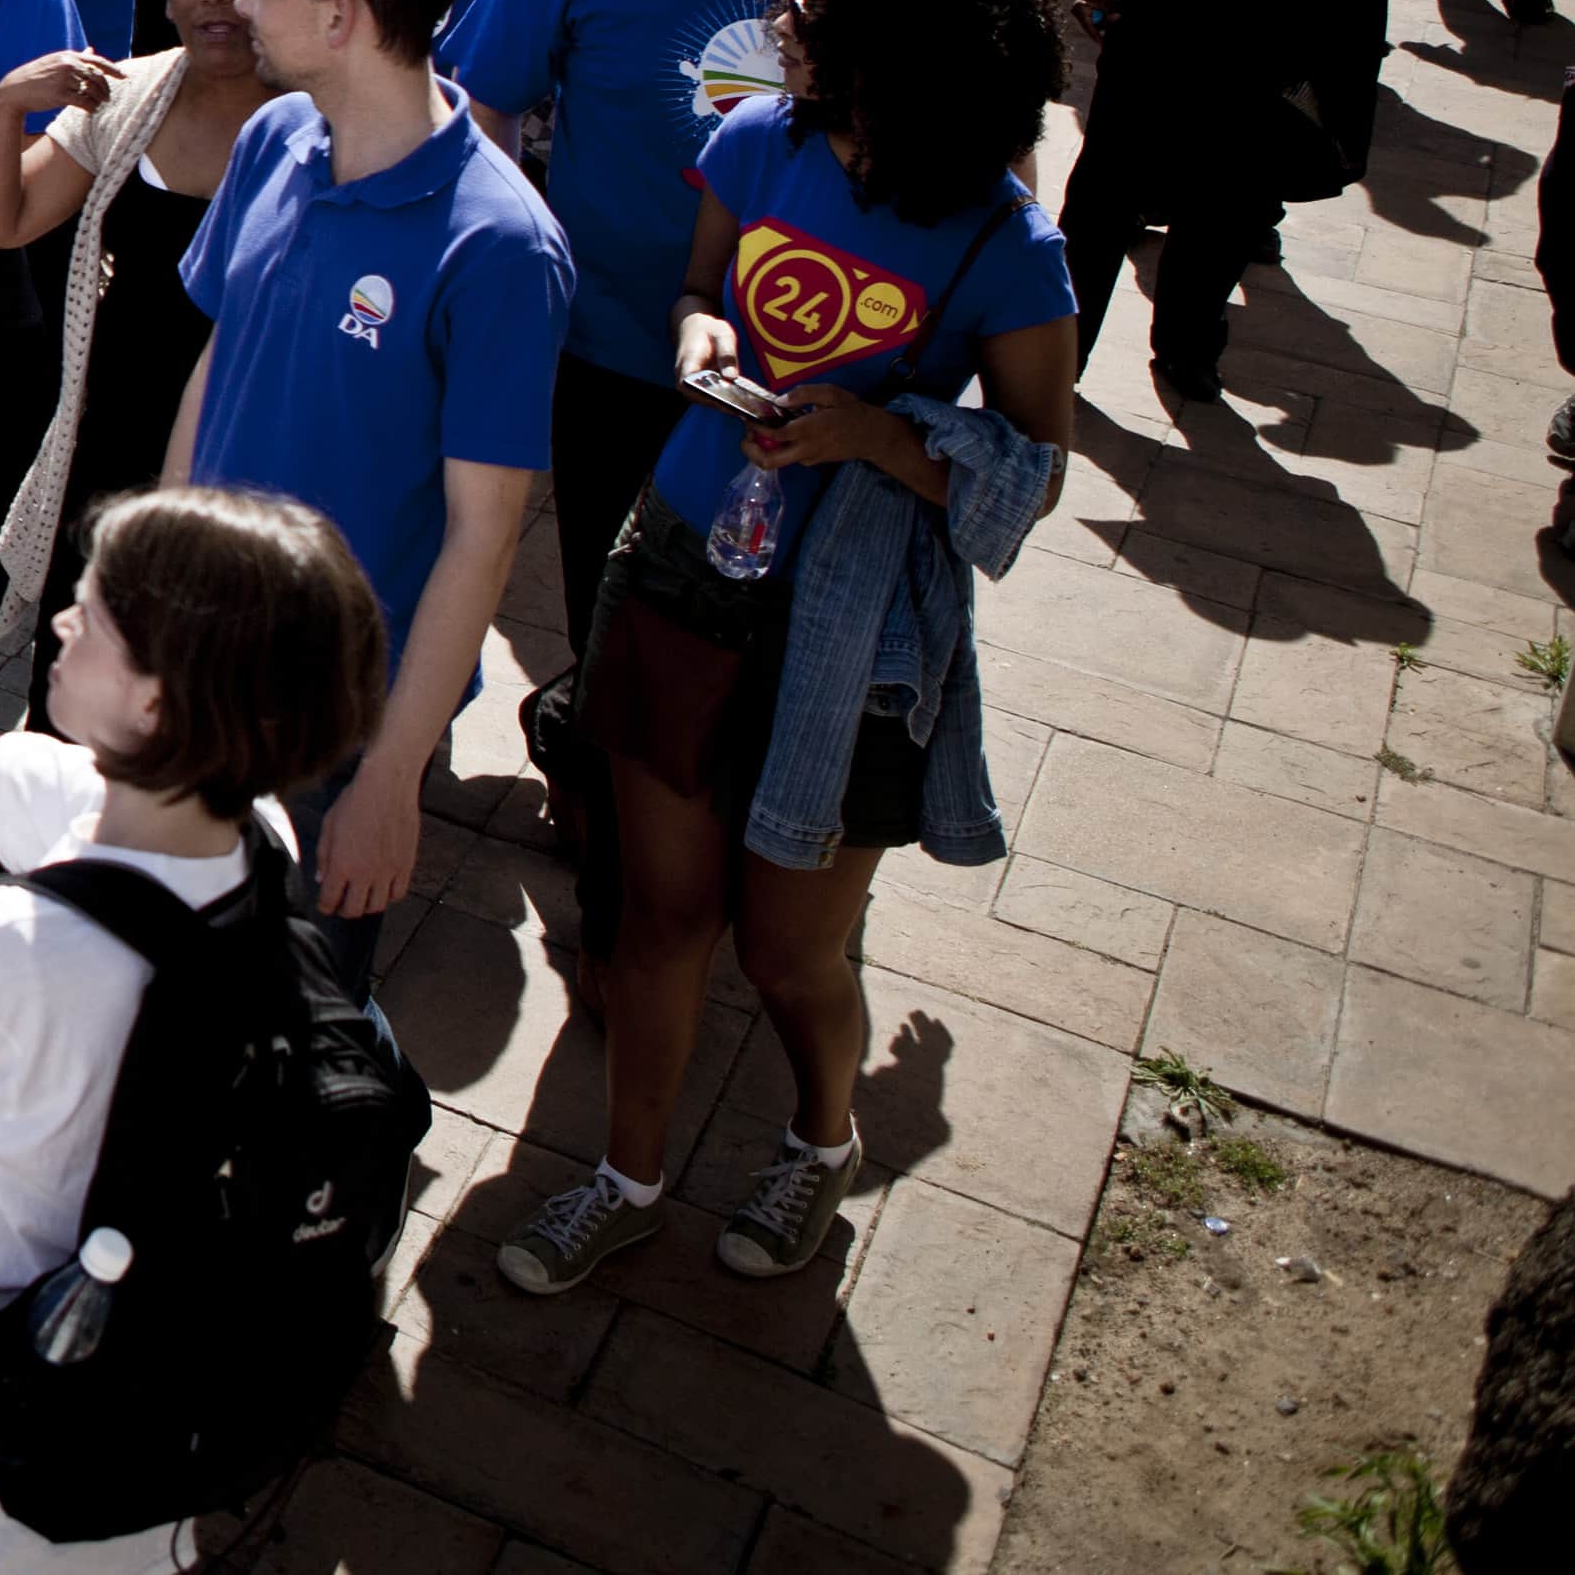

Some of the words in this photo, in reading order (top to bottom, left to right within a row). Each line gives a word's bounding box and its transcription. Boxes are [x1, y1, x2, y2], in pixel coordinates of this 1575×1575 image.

[762, 276, 829, 334] 24
[859, 295, 900, 321] .com
[337, 313, 381, 350] DA
